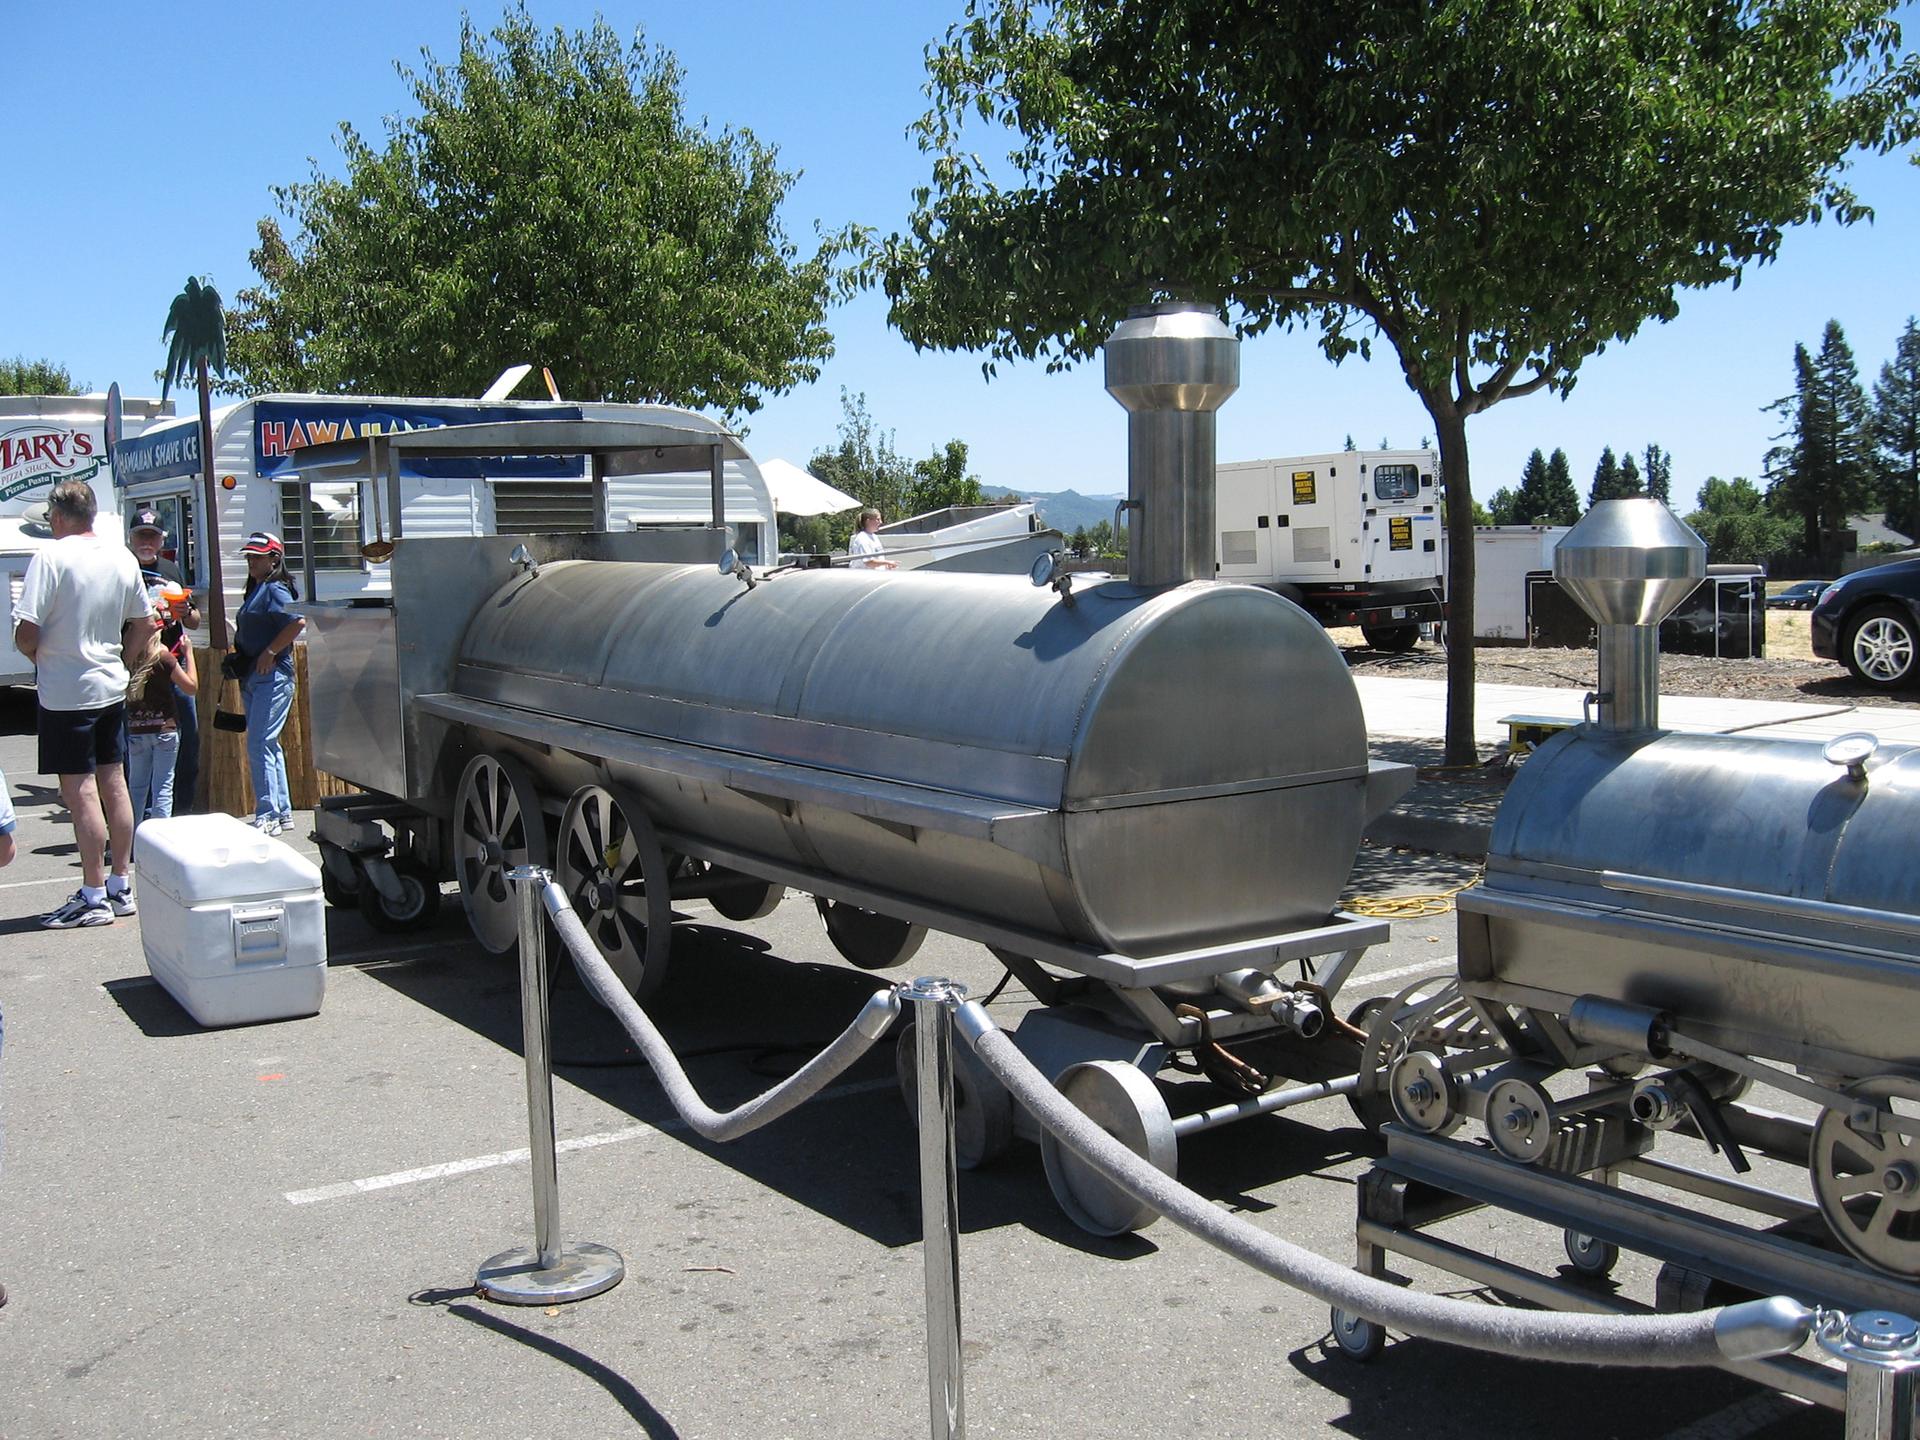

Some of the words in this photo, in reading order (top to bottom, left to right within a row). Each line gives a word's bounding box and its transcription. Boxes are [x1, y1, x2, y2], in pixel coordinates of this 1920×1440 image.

[261, 418, 428, 457] HAWA
[155, 440, 180, 468] SHAVE
[183, 436, 197, 461] ICE
[1, 470, 23, 486] PIZZA
[24, 462, 50, 475] SHACK
[5, 482, 28, 497] Pizza,
[28, 476, 50, 487] Pasta
